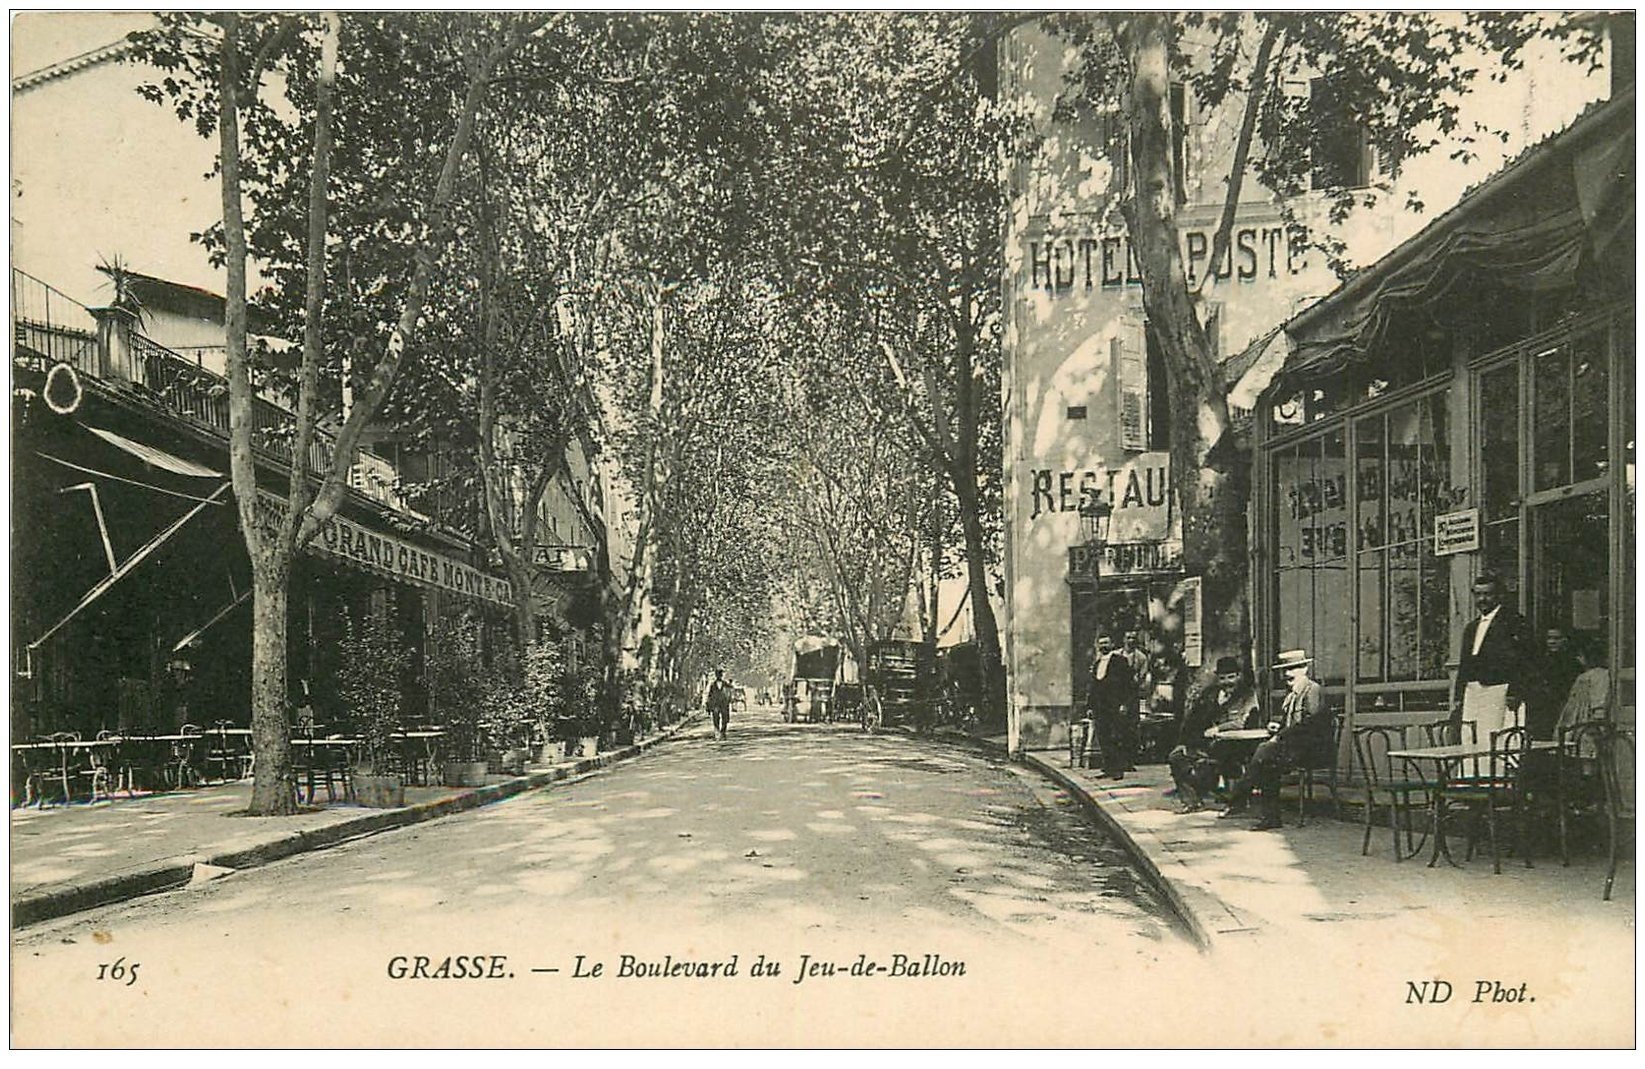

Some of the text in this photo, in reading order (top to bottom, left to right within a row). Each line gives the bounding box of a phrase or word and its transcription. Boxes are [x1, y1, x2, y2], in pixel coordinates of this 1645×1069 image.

[1031, 226, 1308, 290] HOTEL POSTE
[323, 521, 394, 568] GRAND
